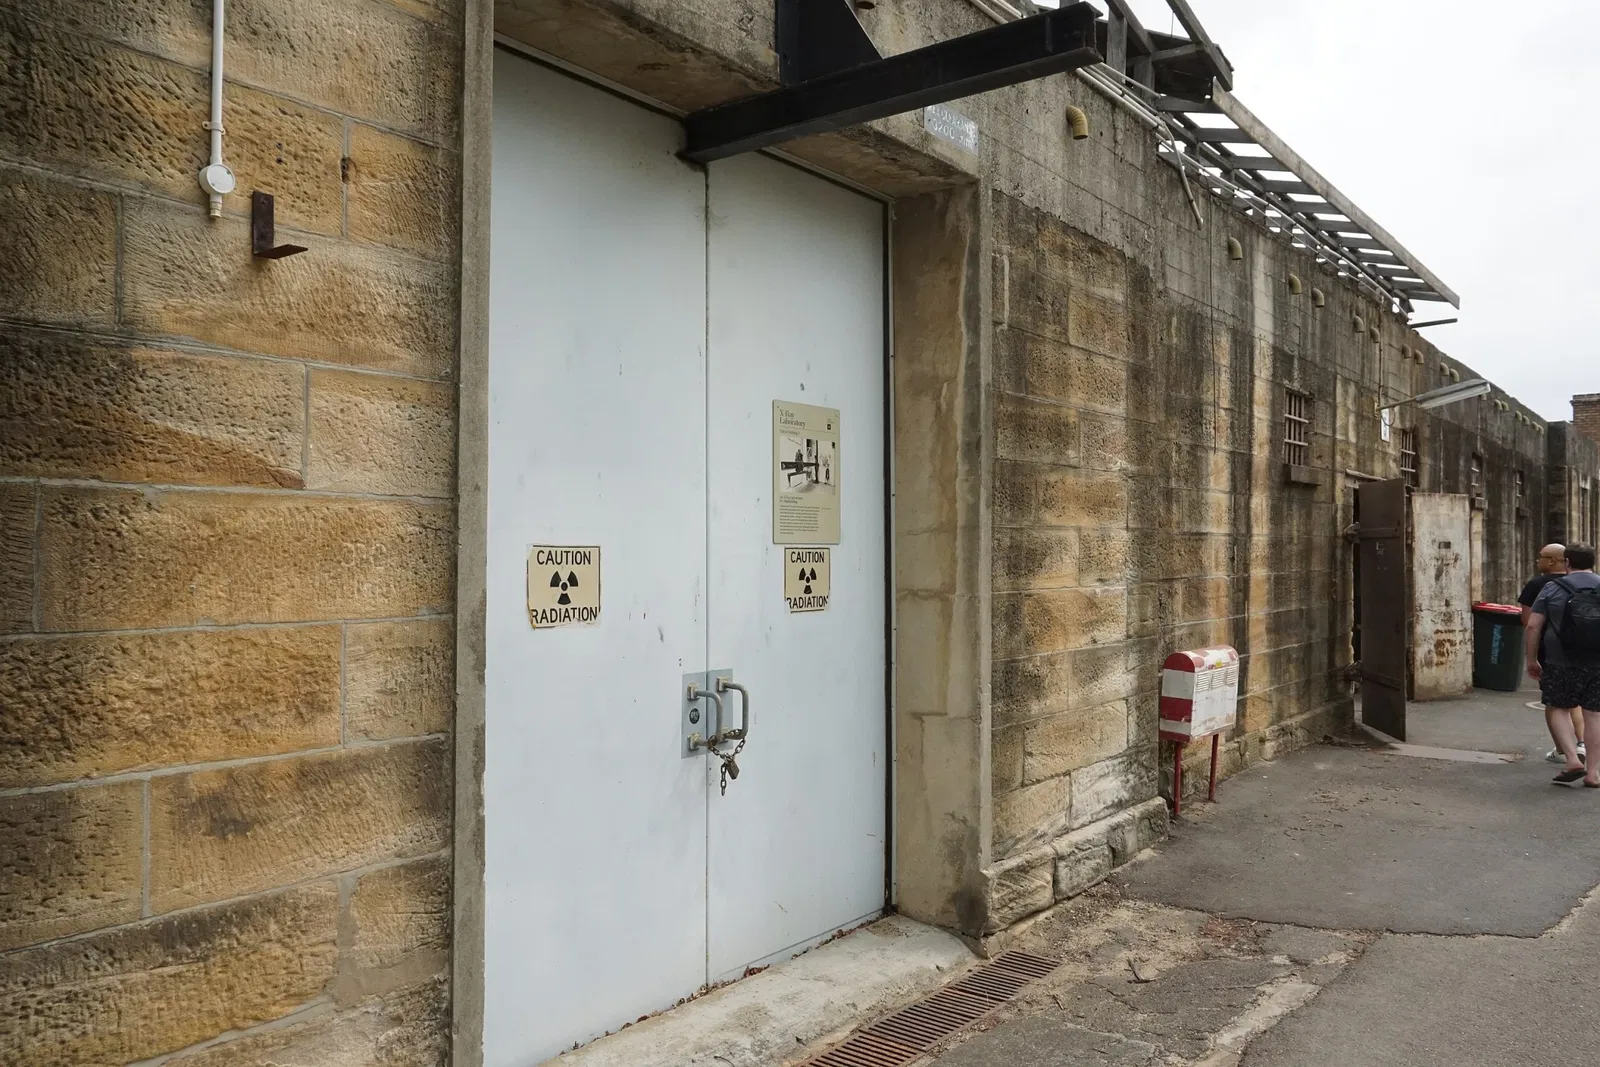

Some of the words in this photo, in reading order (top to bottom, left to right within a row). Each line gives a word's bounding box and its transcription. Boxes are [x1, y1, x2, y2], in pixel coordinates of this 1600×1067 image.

[779, 409, 795, 419] X-Ray
[779, 416, 806, 429] Laboratory
[537, 550, 591, 565] CAUTION
[790, 551, 825, 563] CAUTION
[530, 606, 598, 624] RADIATION
